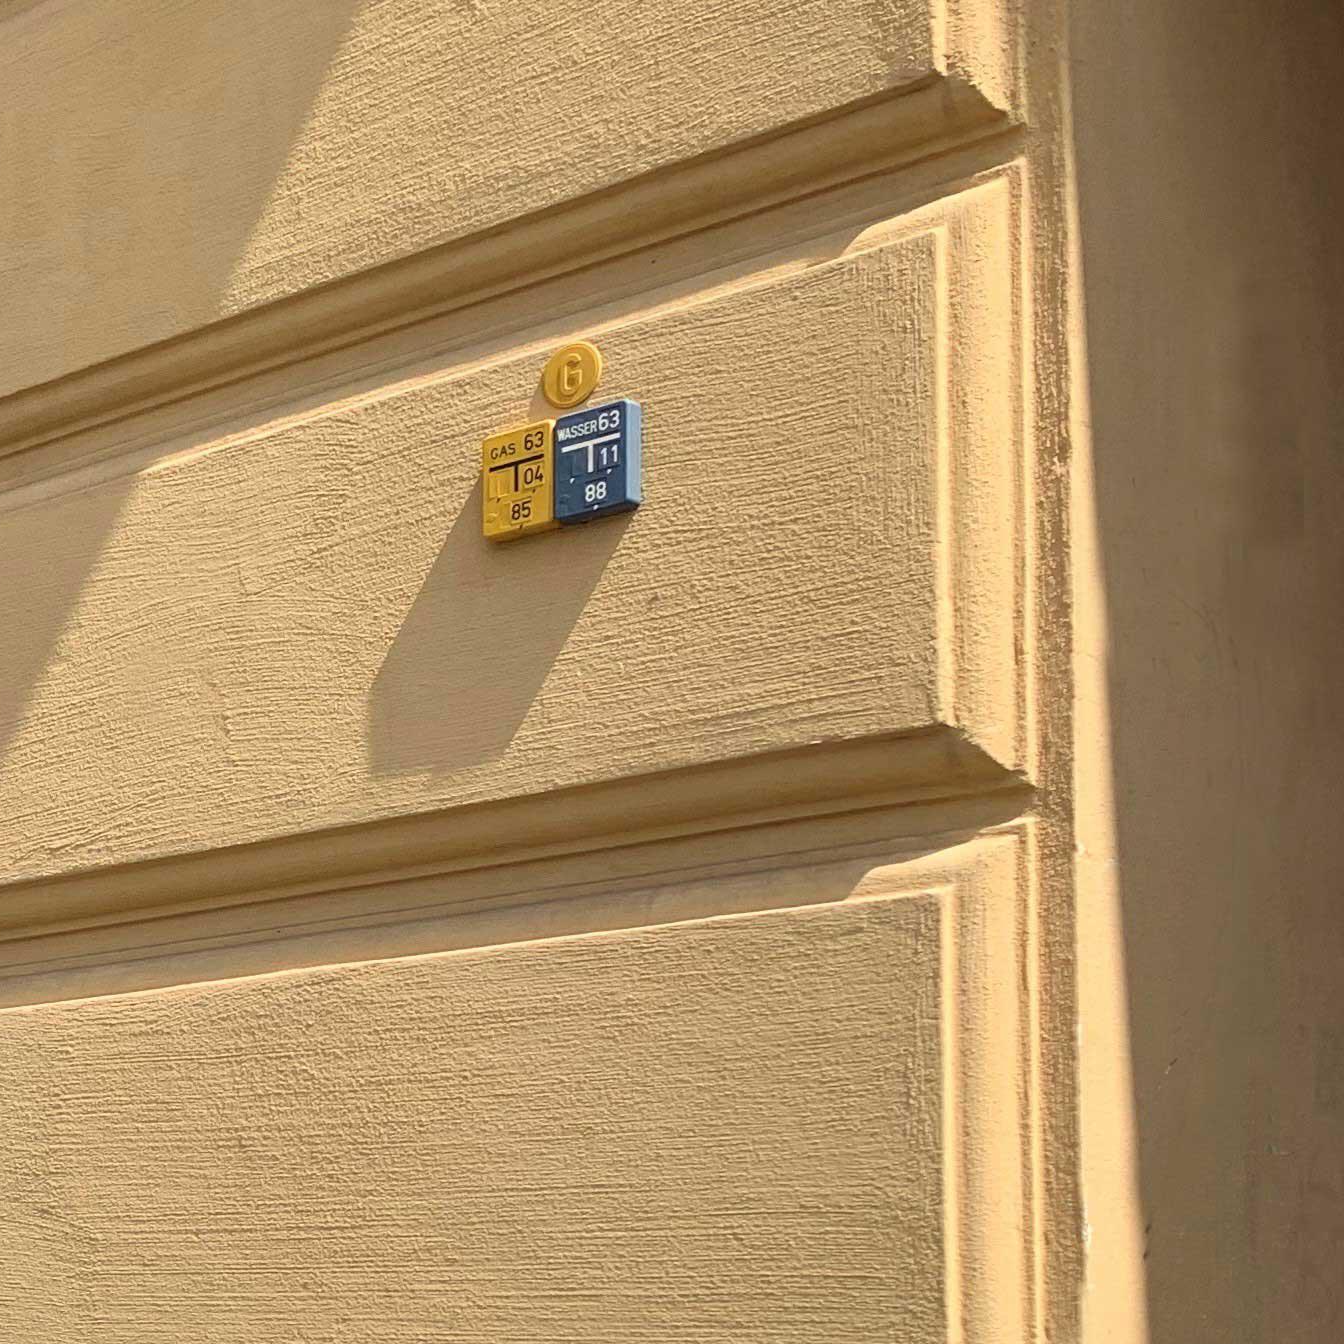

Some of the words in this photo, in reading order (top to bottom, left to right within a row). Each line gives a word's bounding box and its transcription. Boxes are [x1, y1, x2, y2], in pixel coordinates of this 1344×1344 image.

[562, 352, 583, 391] G
[557, 419, 598, 442] WASSER
[598, 409, 621, 432] 63
[490, 442, 516, 461] GAS
[523, 430, 545, 452] 63
[599, 444, 619, 466] 11
[523, 465, 544, 486] 04
[584, 481, 608, 503] 88
[511, 500, 532, 522] 85
